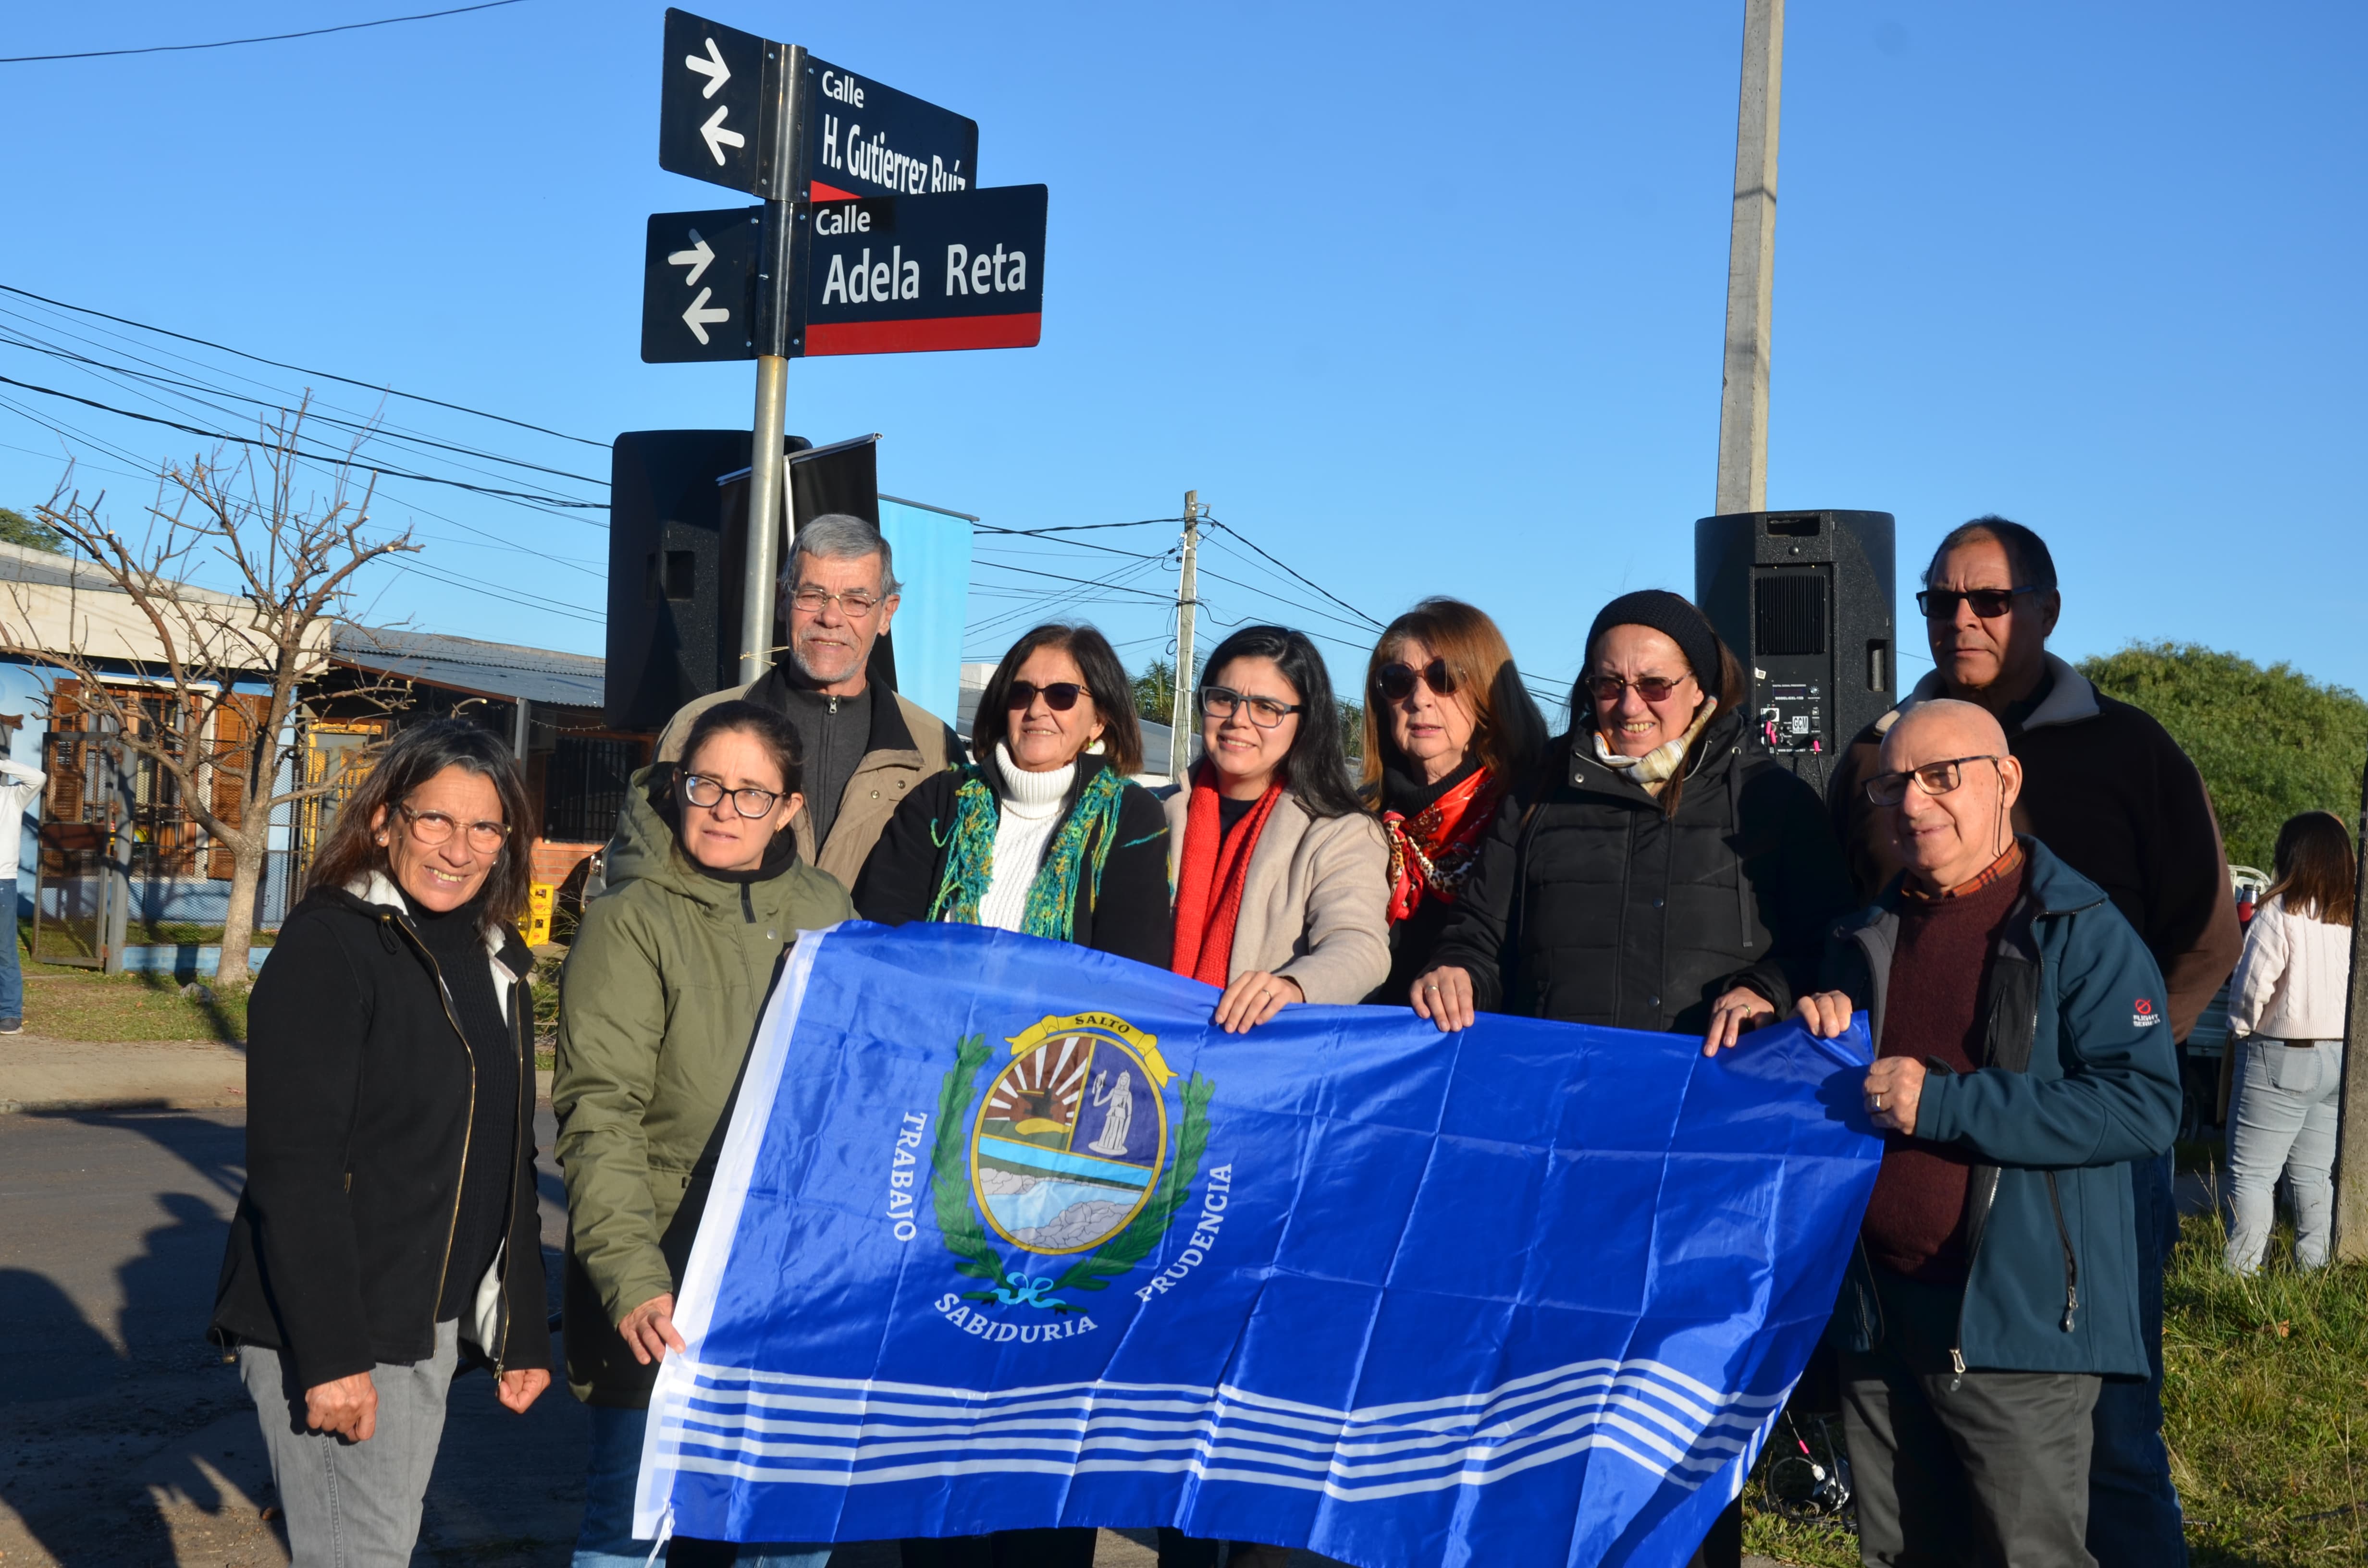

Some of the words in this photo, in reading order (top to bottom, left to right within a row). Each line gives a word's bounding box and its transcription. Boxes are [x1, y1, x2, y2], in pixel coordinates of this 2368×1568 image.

[822, 70, 864, 109] Calle
[822, 113, 842, 170] H.
[847, 123, 928, 195] Gutierrez
[815, 204, 871, 235] Calle
[822, 245, 920, 305] Adela
[946, 243, 1026, 296] Reta
[1793, 717, 1807, 728] GCM
[1075, 1015, 1130, 1033] SALTO
[886, 1112, 928, 1241] TRABAJO
[1134, 1164, 1232, 1302] PRUDENCIA
[935, 1293, 1098, 1343] SABIDURIA
